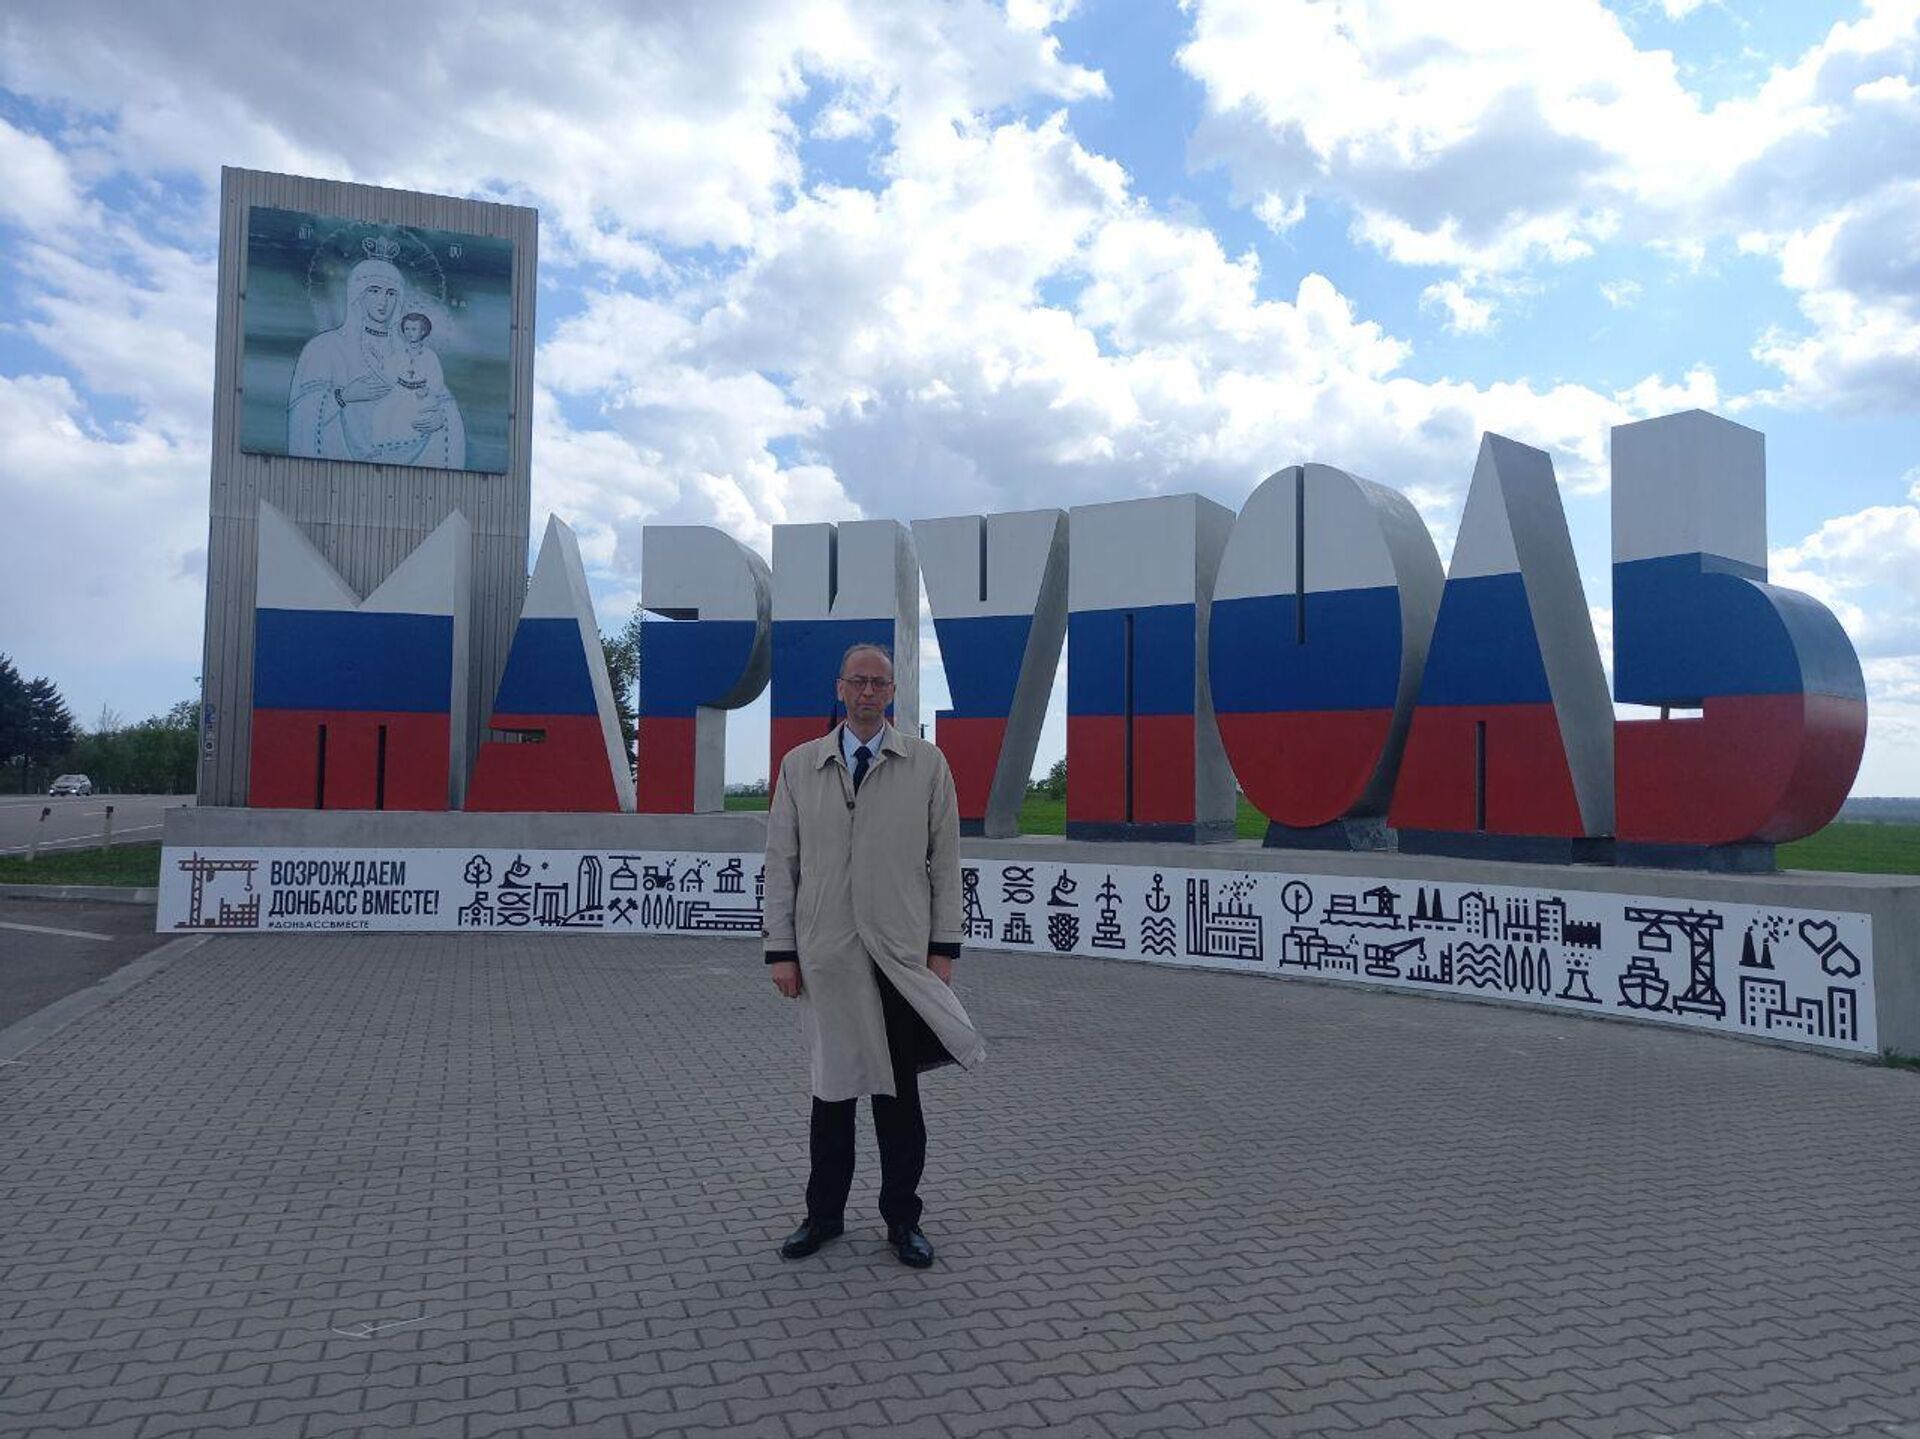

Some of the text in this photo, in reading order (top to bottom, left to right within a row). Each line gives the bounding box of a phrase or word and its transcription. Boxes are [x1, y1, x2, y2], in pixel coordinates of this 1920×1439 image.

[250, 409, 1867, 848] МАРИУПОЛЬ
[270, 860, 407, 888] ВОЗРОЖДАЕМ
[268, 889, 440, 918] ДОНБАСС ВМЕСТЕ!
[268, 920, 370, 929] #ДОНБАССВМЕСТЕ
